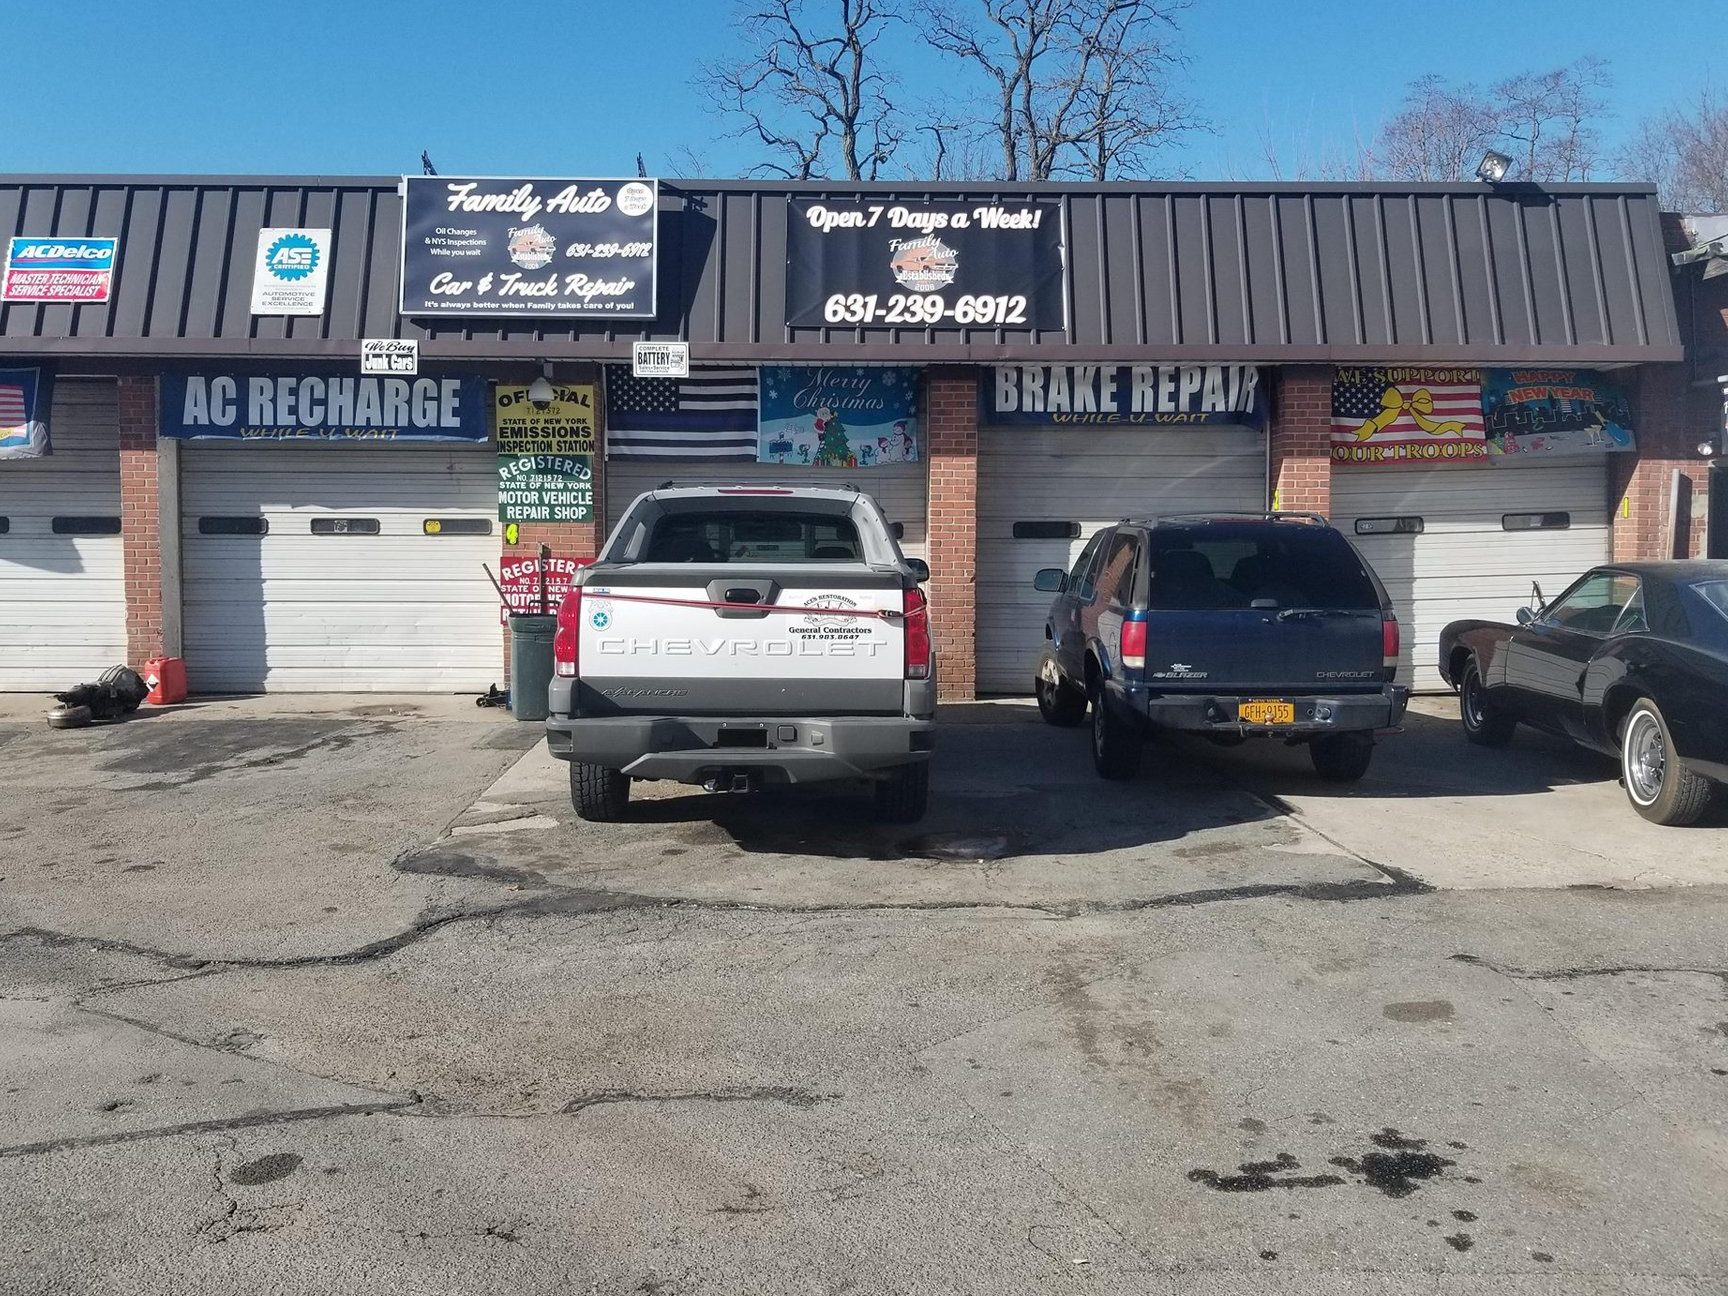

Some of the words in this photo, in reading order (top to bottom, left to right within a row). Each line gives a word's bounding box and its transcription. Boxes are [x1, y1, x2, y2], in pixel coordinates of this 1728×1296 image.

[447, 182, 542, 222] Family
[546, 184, 612, 214] Auto
[806, 205, 866, 232] Open
[866, 206, 884, 228] 7
[887, 206, 948, 234] Days
[950, 212, 970, 228] a
[972, 206, 1042, 229] Week!
[447, 228, 478, 238] Changes
[17, 244, 112, 259] ACDelco
[447, 239, 487, 247] Inspections
[566, 242, 652, 258] 631-239-6912
[888, 233, 942, 253] Family
[927, 246, 959, 260] Auto
[270, 247, 313, 264] ASE
[10, 273, 50, 284] MASTER
[50, 274, 102, 285] TECHNICIAN
[8, 285, 48, 296] SERVICE
[48, 286, 100, 296] SPECIALIST
[430, 272, 473, 295] Car
[477, 272, 494, 296] &
[498, 272, 558, 296] Truck
[564, 273, 636, 304] Repair
[440, 302, 470, 310] always
[528, 302, 556, 310] Family
[824, 294, 1027, 324] 631-239-6912
[364, 340, 386, 352] We
[386, 341, 416, 354] Buy
[366, 354, 389, 370] Junk
[390, 354, 414, 370] Cars
[638, 352, 670, 366] BATTERY
[806, 367, 872, 397] Merry
[995, 366, 1118, 412] BRAKE
[1130, 366, 1259, 414] REPAIR
[182, 376, 237, 426] AC
[248, 376, 461, 428] RECHARGE
[498, 388, 590, 408] OFIAL
[793, 386, 884, 410] Christmas
[1508, 386, 1548, 404] NEW
[1552, 386, 1594, 401] YEAR
[500, 426, 592, 439] EMISSIONS
[496, 440, 553, 452] INSPECTION
[556, 440, 595, 452] STATION
[1332, 446, 1384, 462] OUR
[1391, 443, 1484, 460] TROOPS
[498, 456, 592, 480] REGISTERED
[498, 492, 540, 504] MOTOR
[542, 492, 593, 504] VEHICLE
[507, 506, 550, 519] REPAIR
[554, 506, 587, 520] SHOP
[597, 638, 888, 657] CHEVROLET
